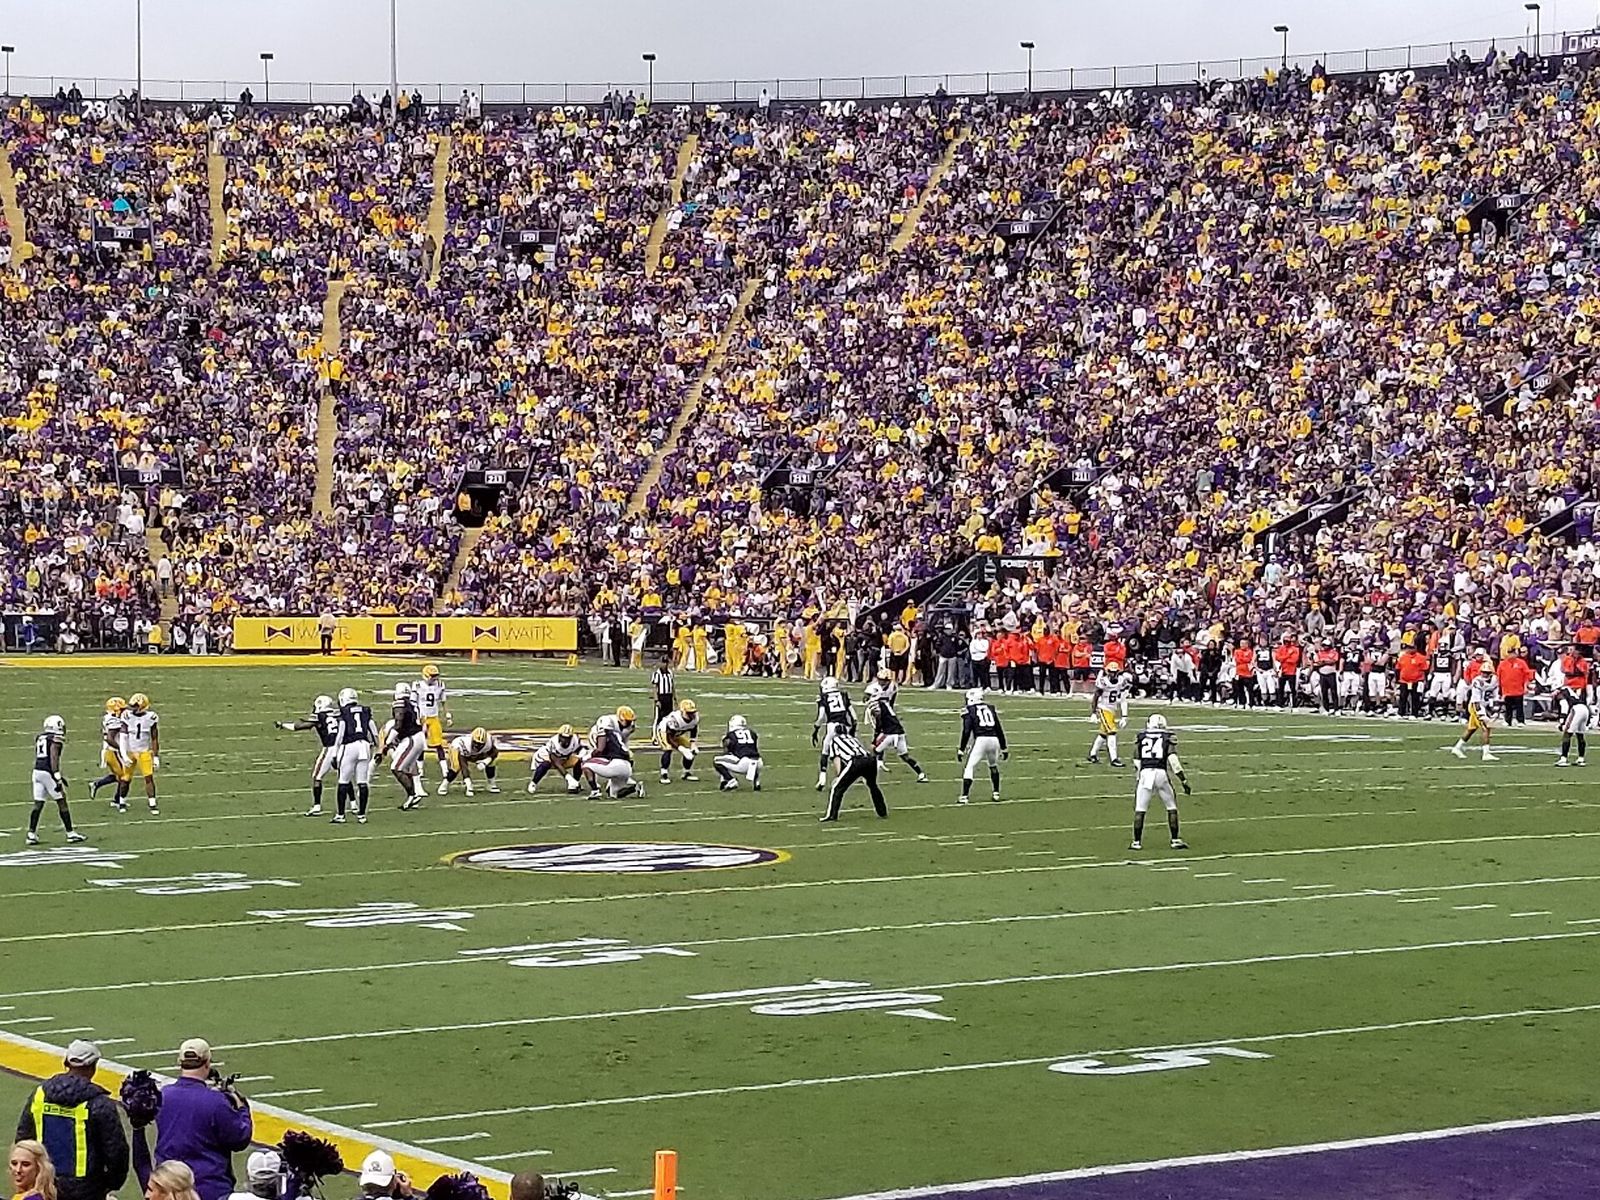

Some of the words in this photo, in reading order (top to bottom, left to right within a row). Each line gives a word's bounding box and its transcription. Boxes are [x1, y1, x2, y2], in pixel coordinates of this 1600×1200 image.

[375, 623, 442, 644] LSU
[503, 626, 555, 640] WAITR
[426, 693, 435, 707] 9
[326, 716, 339, 734] 2
[353, 712, 363, 733] 1
[976, 705, 996, 726] 10
[135, 723, 142, 739] 1
[736, 728, 755, 744] 91
[1141, 738, 1164, 758] 24
[247, 902, 474, 928] 20
[457, 937, 698, 967] 15
[686, 980, 945, 1016] 10
[1048, 1047, 1272, 1075] 5
